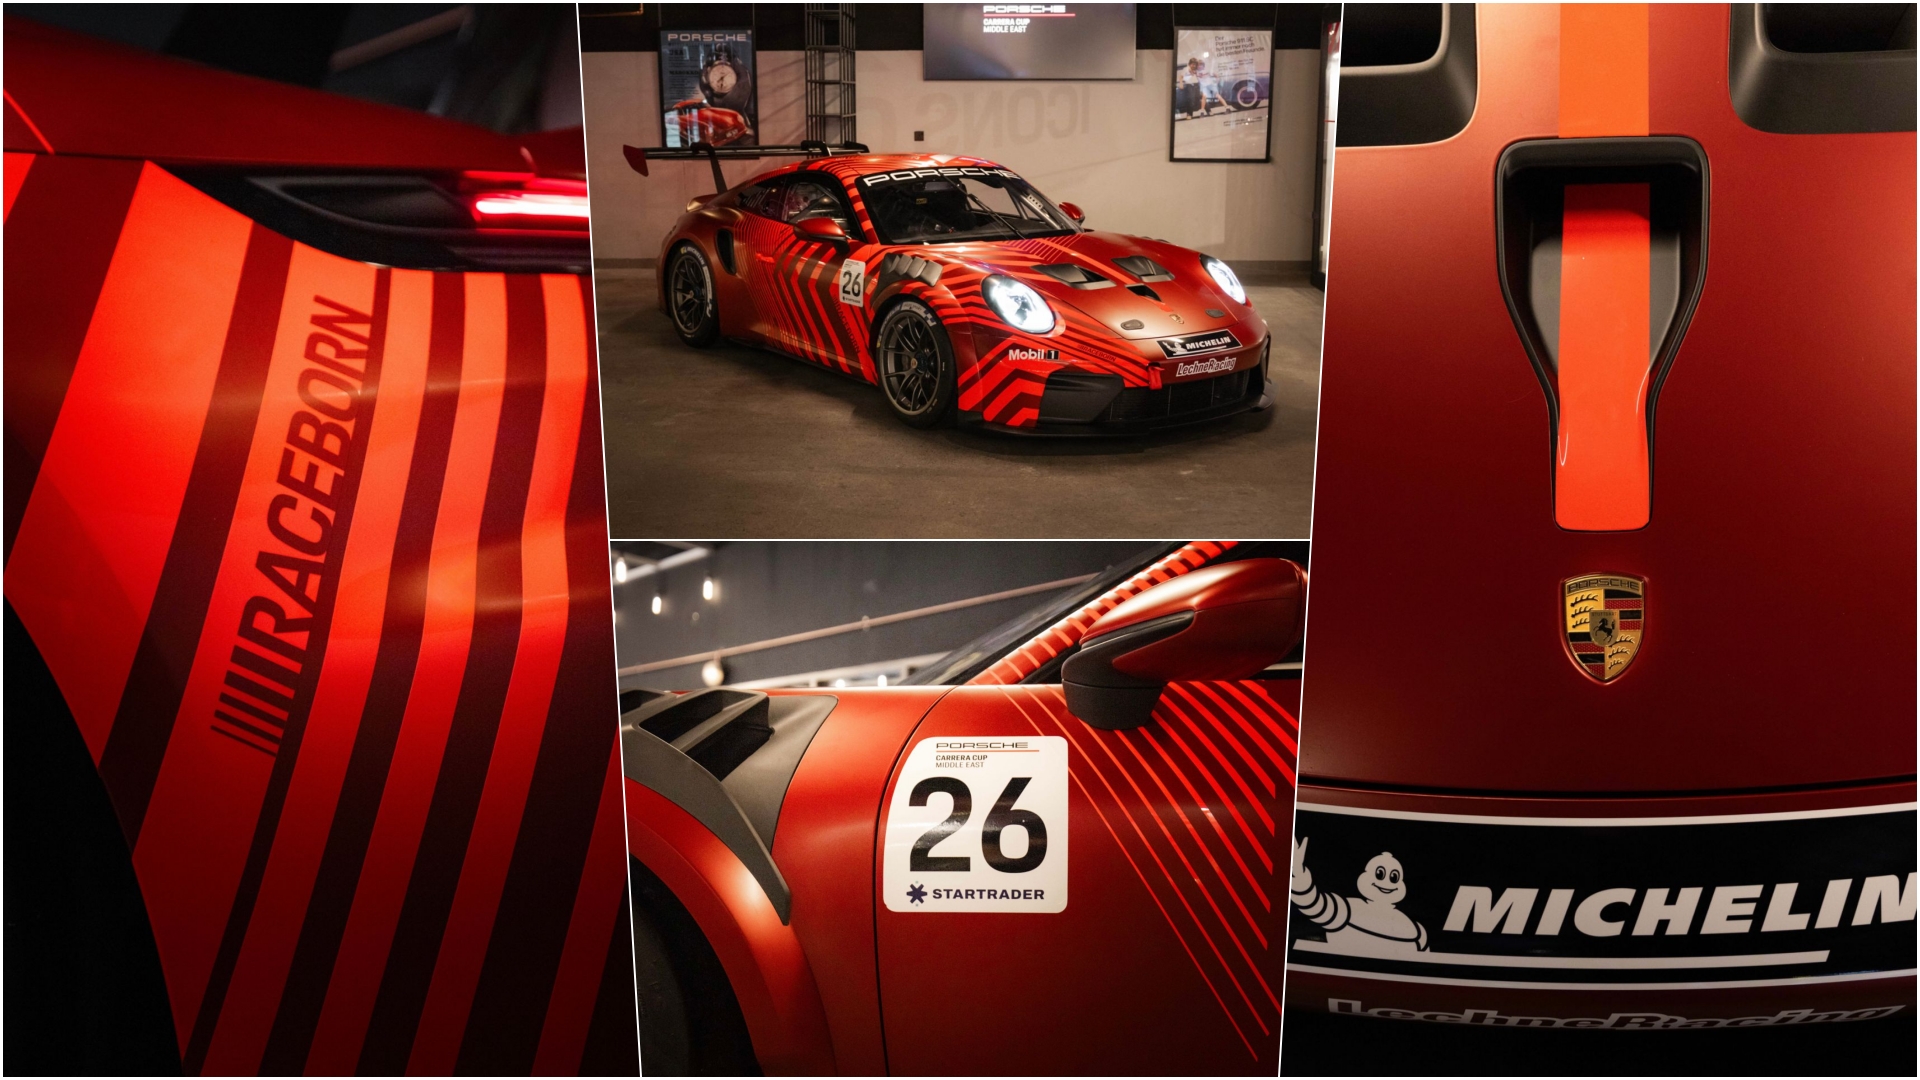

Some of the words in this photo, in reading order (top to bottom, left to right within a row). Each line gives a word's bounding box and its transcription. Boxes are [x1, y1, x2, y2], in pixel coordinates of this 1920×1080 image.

[983, 5, 1066, 13] PORSCHE
[983, 18, 1015, 26] CARRERA
[1016, 18, 1030, 26] CUP
[667, 33, 747, 42] PORSCHE
[863, 168, 1020, 187] PORSCHE
[842, 270, 862, 297] 26
[1185, 336, 1231, 350] MICHELIN
[1009, 349, 1045, 361] Mobil
[237, 294, 372, 664] RACEBORN
[1568, 578, 1640, 594] PORSCHE
[909, 776, 1048, 873] 26
[932, 888, 1045, 900] STARTRADER
[1442, 871, 1917, 937] MICHELIN
